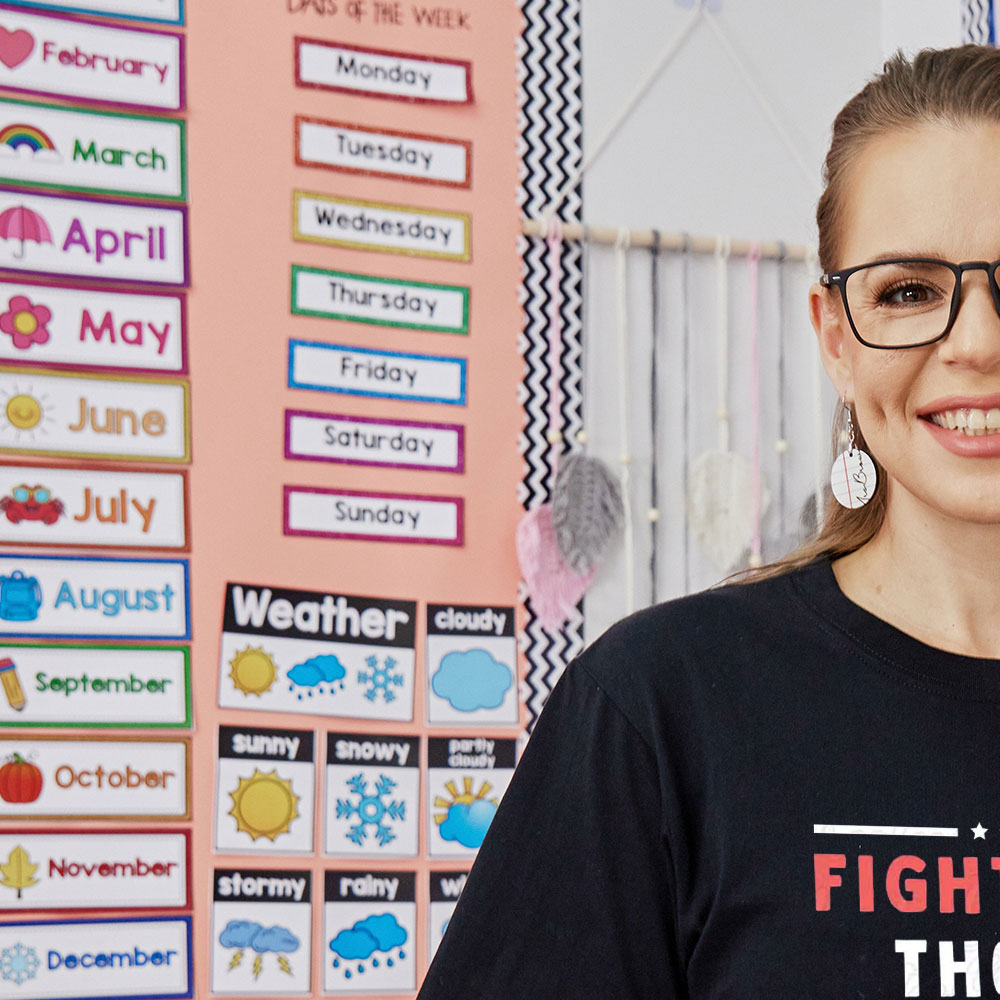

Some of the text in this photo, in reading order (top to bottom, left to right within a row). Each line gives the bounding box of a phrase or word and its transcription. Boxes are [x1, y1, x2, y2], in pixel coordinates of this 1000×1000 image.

[373, 2, 402, 25] THE
[412, 5, 471, 29] WEEK
[42, 41, 168, 83] February
[336, 55, 432, 91] Monday
[72, 139, 167, 171] March
[337, 134, 433, 170] Tuesday
[62, 218, 166, 263] April
[315, 207, 452, 245] Wednesday
[329, 281, 438, 317] Thursday
[79, 309, 170, 354] May
[340, 357, 418, 387] Friday
[69, 397, 166, 436] June
[325, 424, 434, 457] Saturday
[74, 487, 156, 533] July
[334, 501, 421, 528] Sunday
[54, 581, 174, 616] August
[232, 585, 409, 641] Weather
[434, 608, 507, 635] cloudy
[36, 672, 172, 697] September
[232, 734, 300, 760] sunny
[335, 740, 410, 766] snowy
[448, 737, 495, 755] partly
[448, 752, 496, 769] cloudy
[55, 763, 175, 789] October
[48, 859, 178, 878] November
[217, 872, 306, 901] stormy
[339, 874, 399, 901] rainy
[47, 948, 177, 970] December
